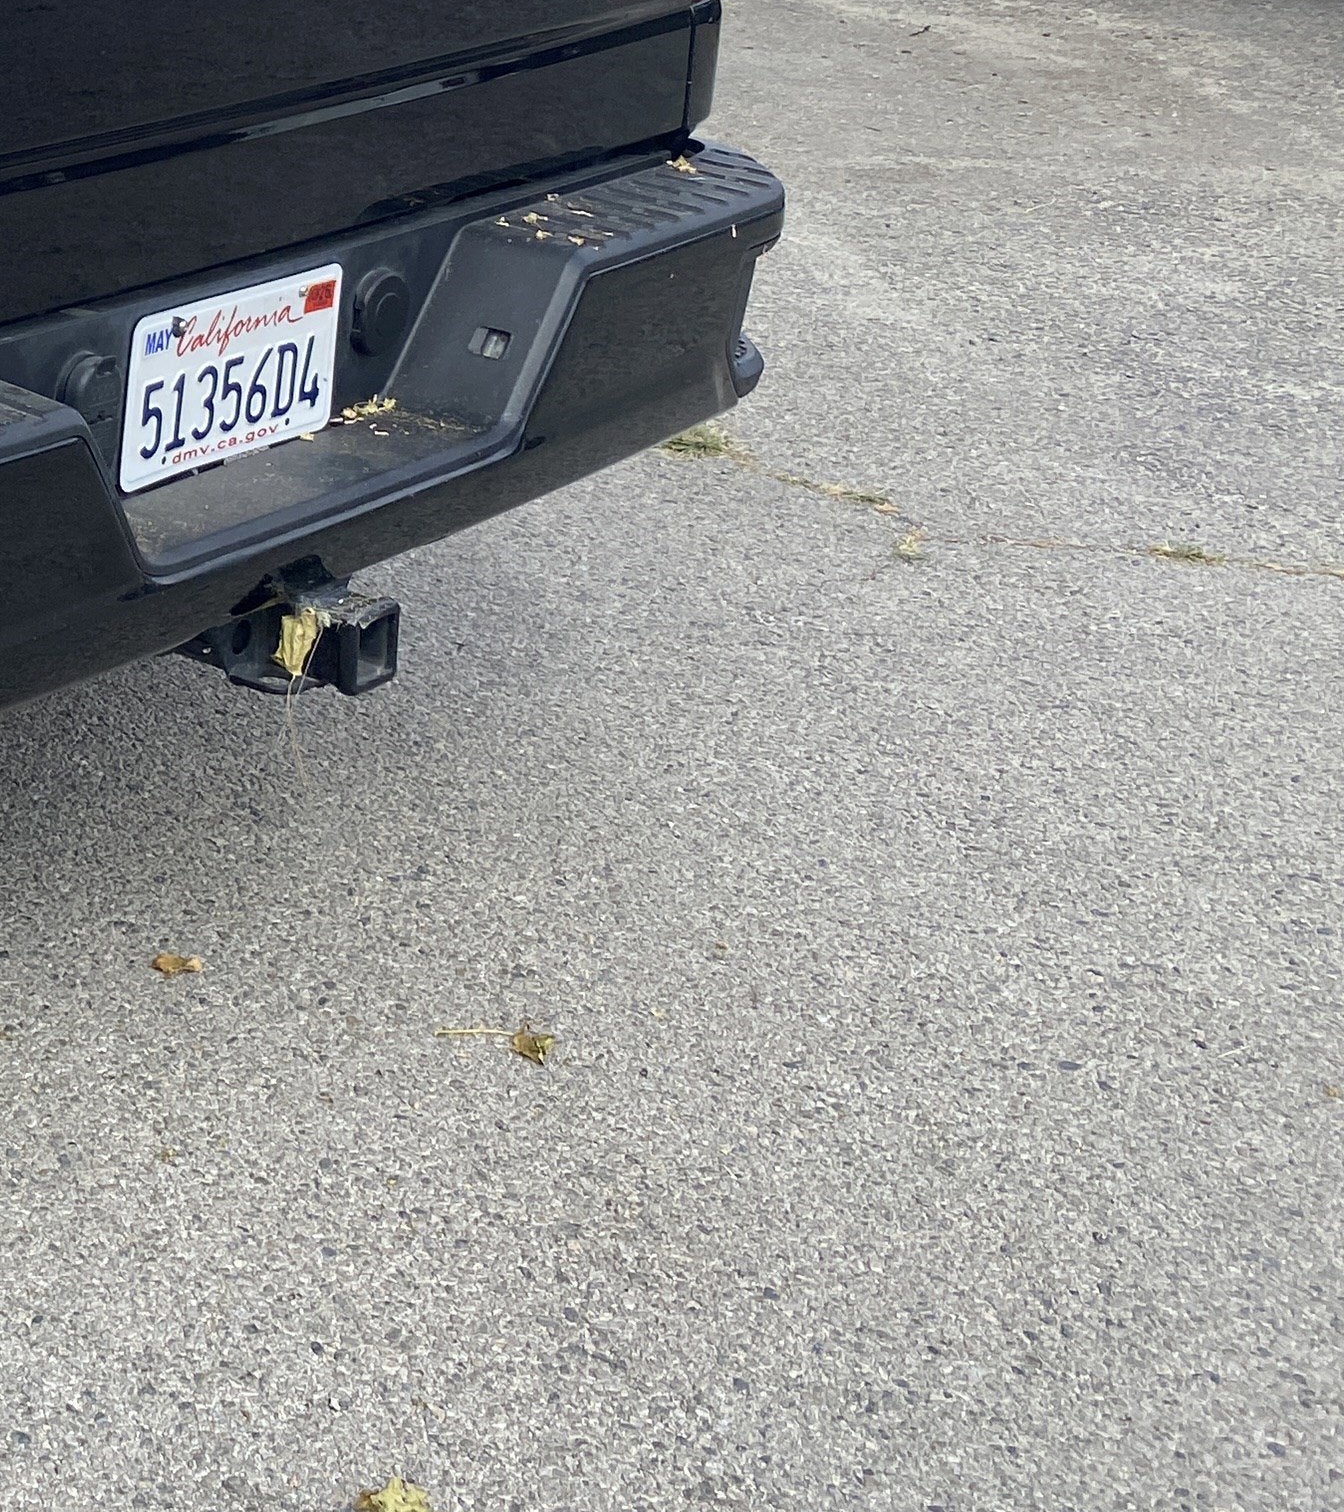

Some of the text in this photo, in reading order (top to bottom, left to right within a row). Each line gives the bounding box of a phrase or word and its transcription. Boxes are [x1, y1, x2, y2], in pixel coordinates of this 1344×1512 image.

[145, 304, 303, 358] MAY California
[139, 335, 320, 460] 51356D4
[171, 423, 279, 465] dmv.ca.gov
